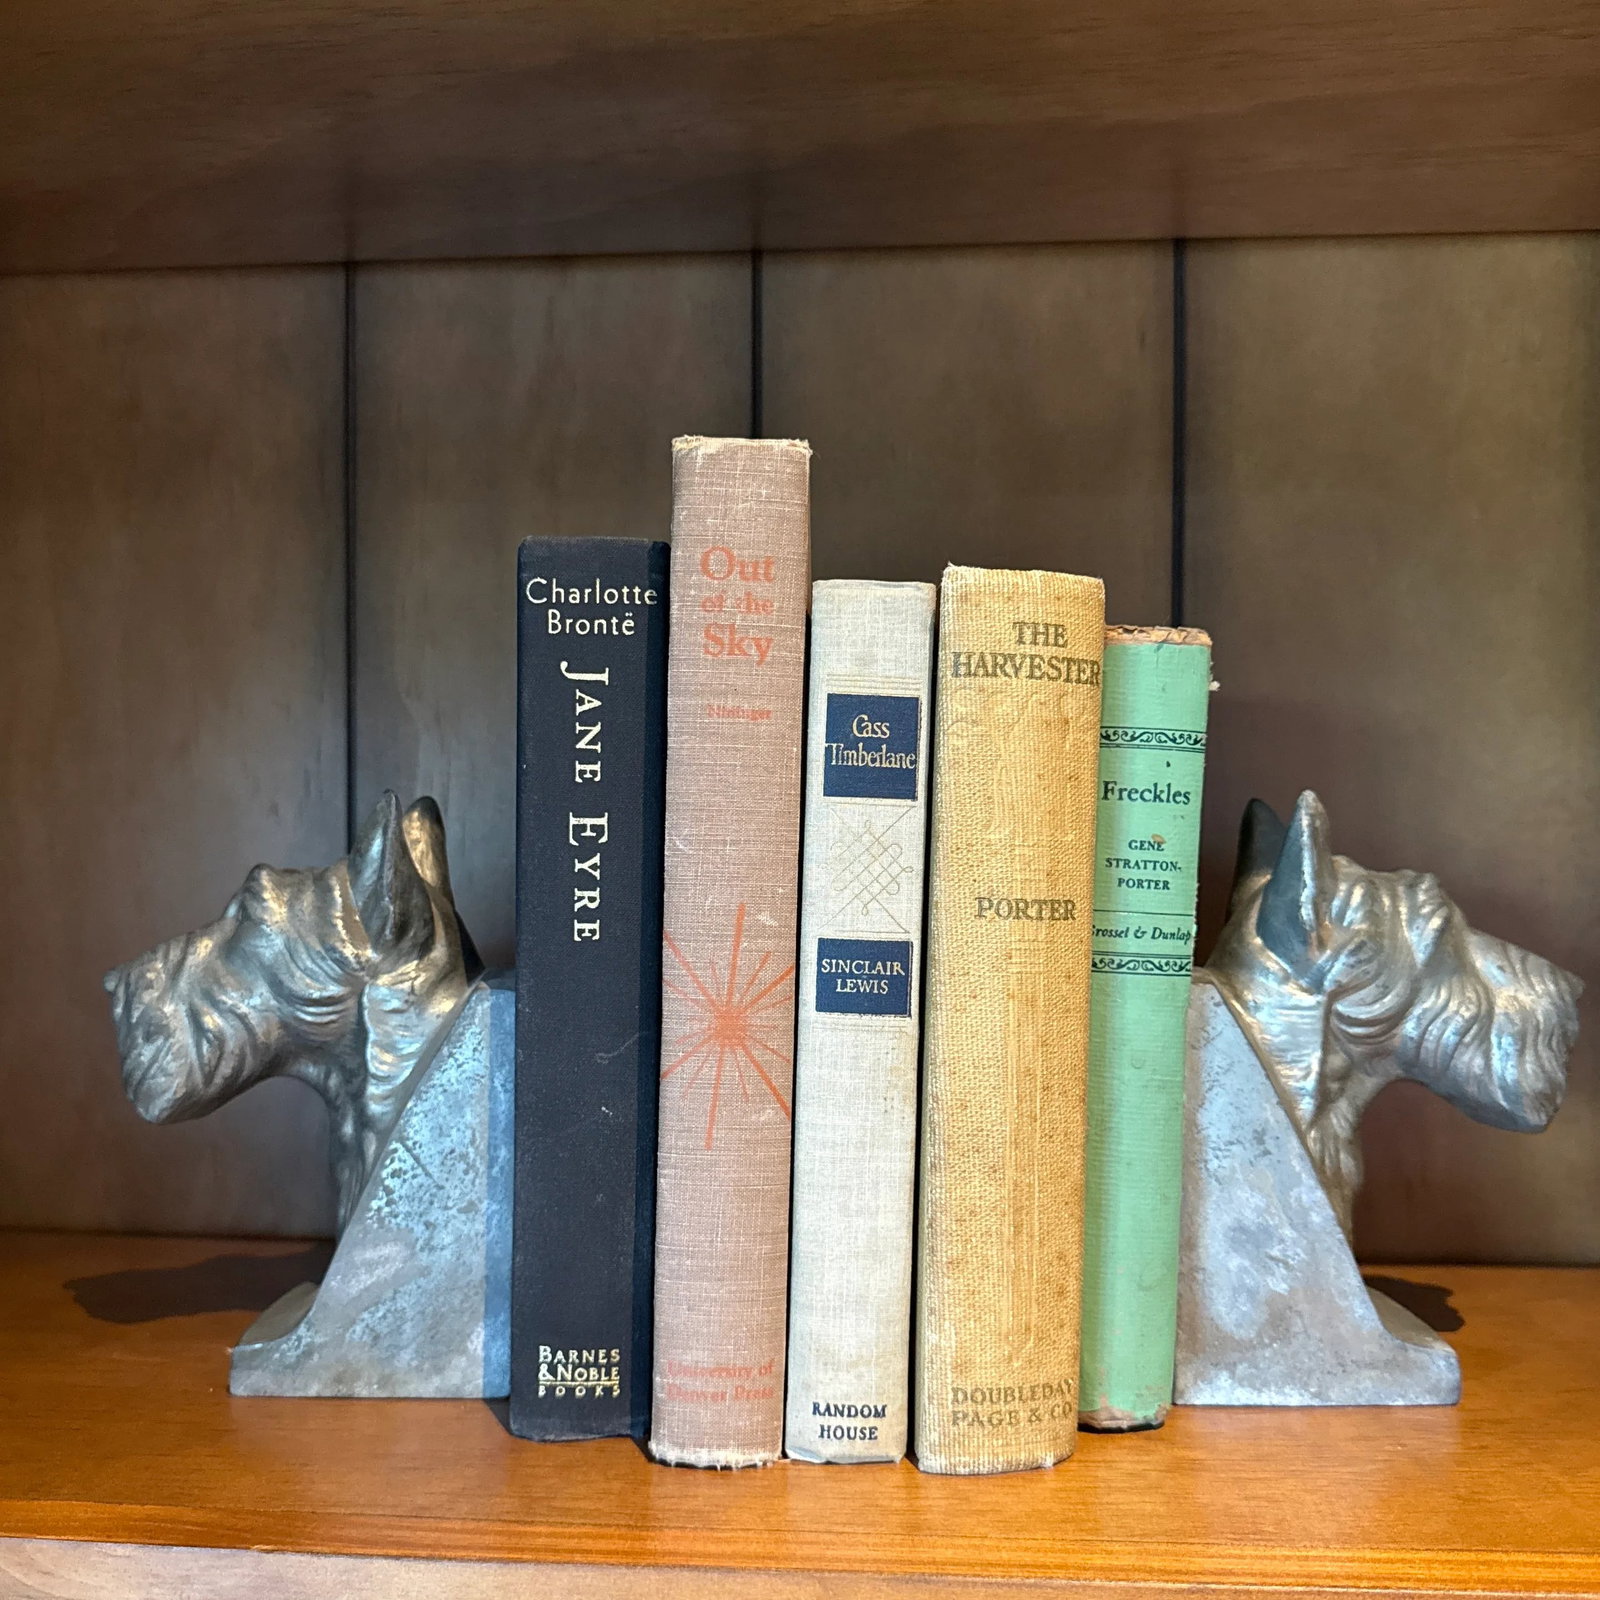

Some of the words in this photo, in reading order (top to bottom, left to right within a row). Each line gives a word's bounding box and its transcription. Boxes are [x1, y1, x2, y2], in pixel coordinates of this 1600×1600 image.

[700, 546, 775, 583] Out
[526, 577, 658, 605] Charlotte
[547, 609, 636, 636] Brontë
[1012, 622, 1068, 648] THE
[703, 621, 775, 667] Sky
[951, 651, 1102, 687] HARVESTER
[560, 660, 609, 784] JANE
[852, 714, 890, 739] Cass
[824, 741, 916, 769] Timberlane
[1101, 780, 1192, 806] Freckles
[1128, 839, 1165, 852] GENE
[569, 811, 609, 942] EYRE
[1105, 858, 1182, 873] STRATTON-
[1117, 878, 1171, 891] PORTER
[974, 896, 1077, 921] PORTER
[1133, 926, 1148, 939] &
[1151, 926, 1192, 946] Dunlap
[821, 958, 905, 976] SINCLAIR
[836, 978, 889, 995] LEWIS
[538, 1345, 620, 1364] BARNES
[950, 1377, 1074, 1405] DOUBLEDAY
[812, 1401, 888, 1419] RANDOM
[951, 1409, 1020, 1428] PAGE
[1028, 1406, 1042, 1424] &
[818, 1423, 879, 1441] HOUSE
